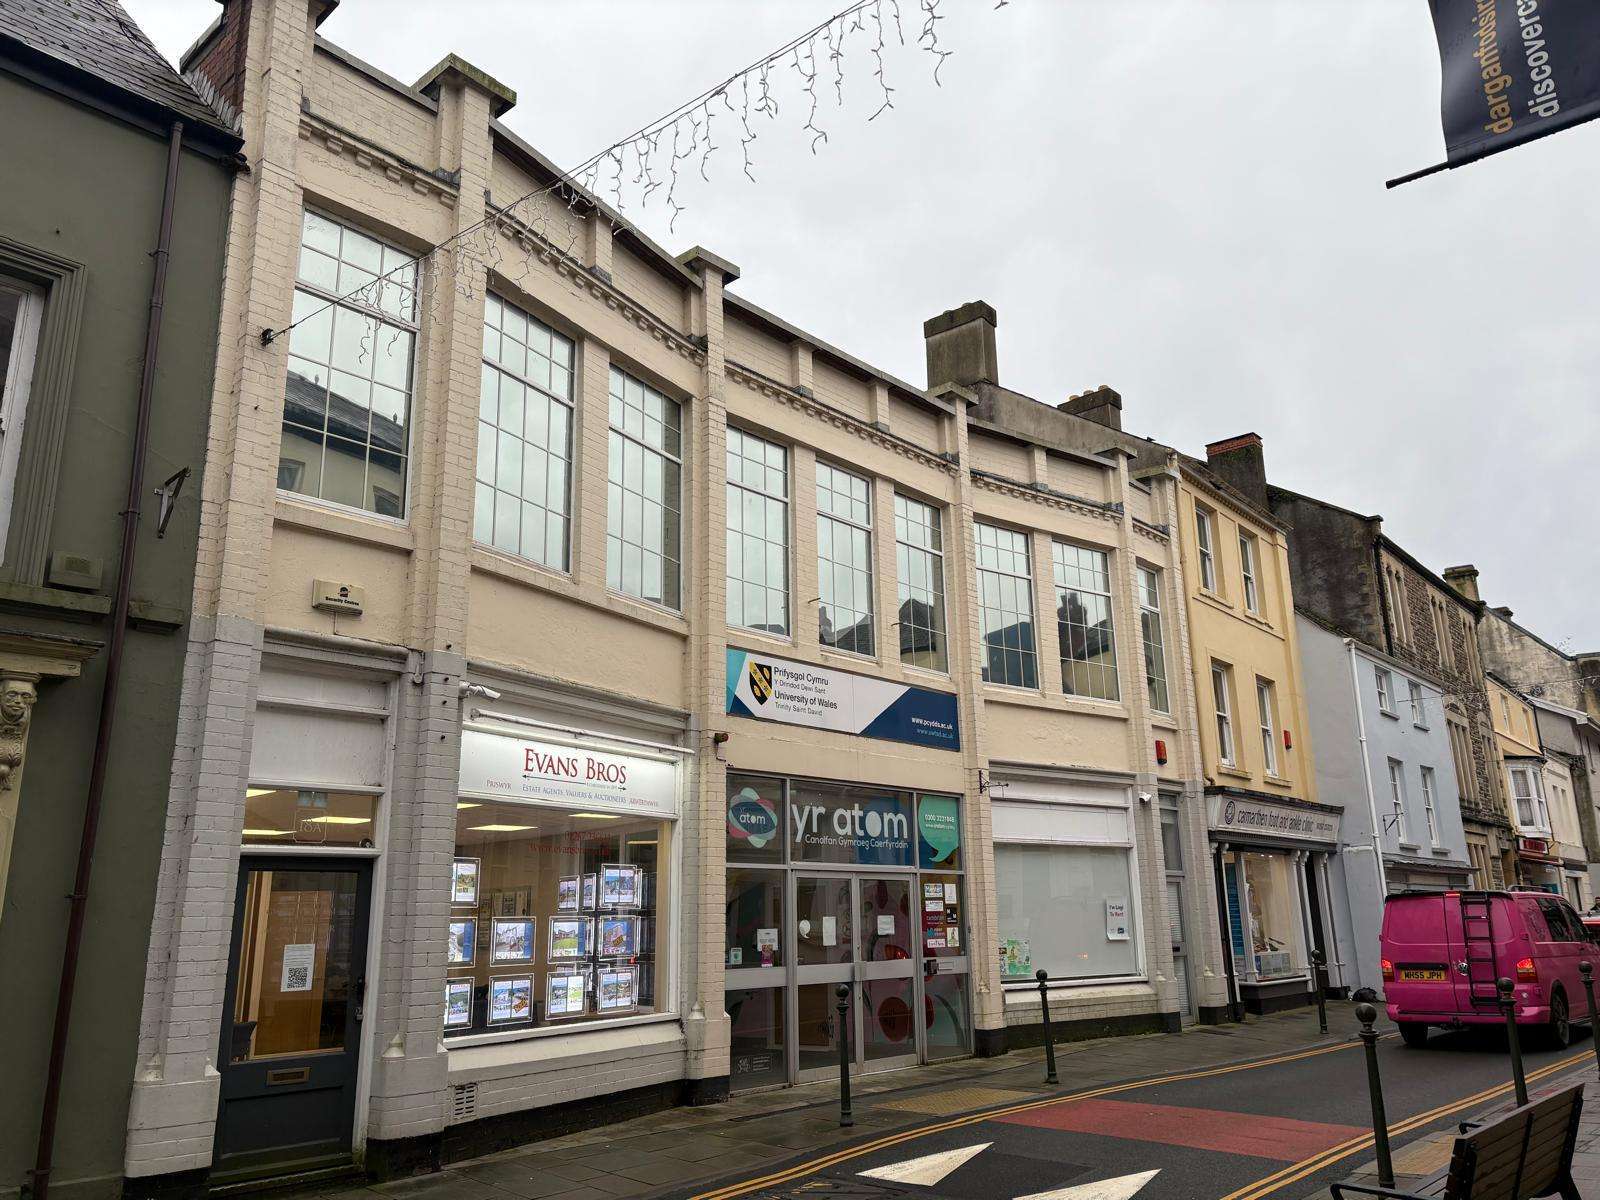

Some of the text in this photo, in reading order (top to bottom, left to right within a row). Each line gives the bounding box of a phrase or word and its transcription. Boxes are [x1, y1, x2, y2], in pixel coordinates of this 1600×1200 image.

[1472, 0, 1514, 134] darganfodsir
[774, 667, 829, 685] Prifysgol Cymru
[775, 690, 838, 709] University of Wales
[524, 748, 627, 784] EVANS BROS
[740, 812, 766, 825] atom
[791, 803, 908, 842] yr atom
[1269, 811, 1279, 828] foot
[1280, 814, 1289, 829] and
[805, 834, 909, 850] Canolfan Gymraeg Caerfyrddin
